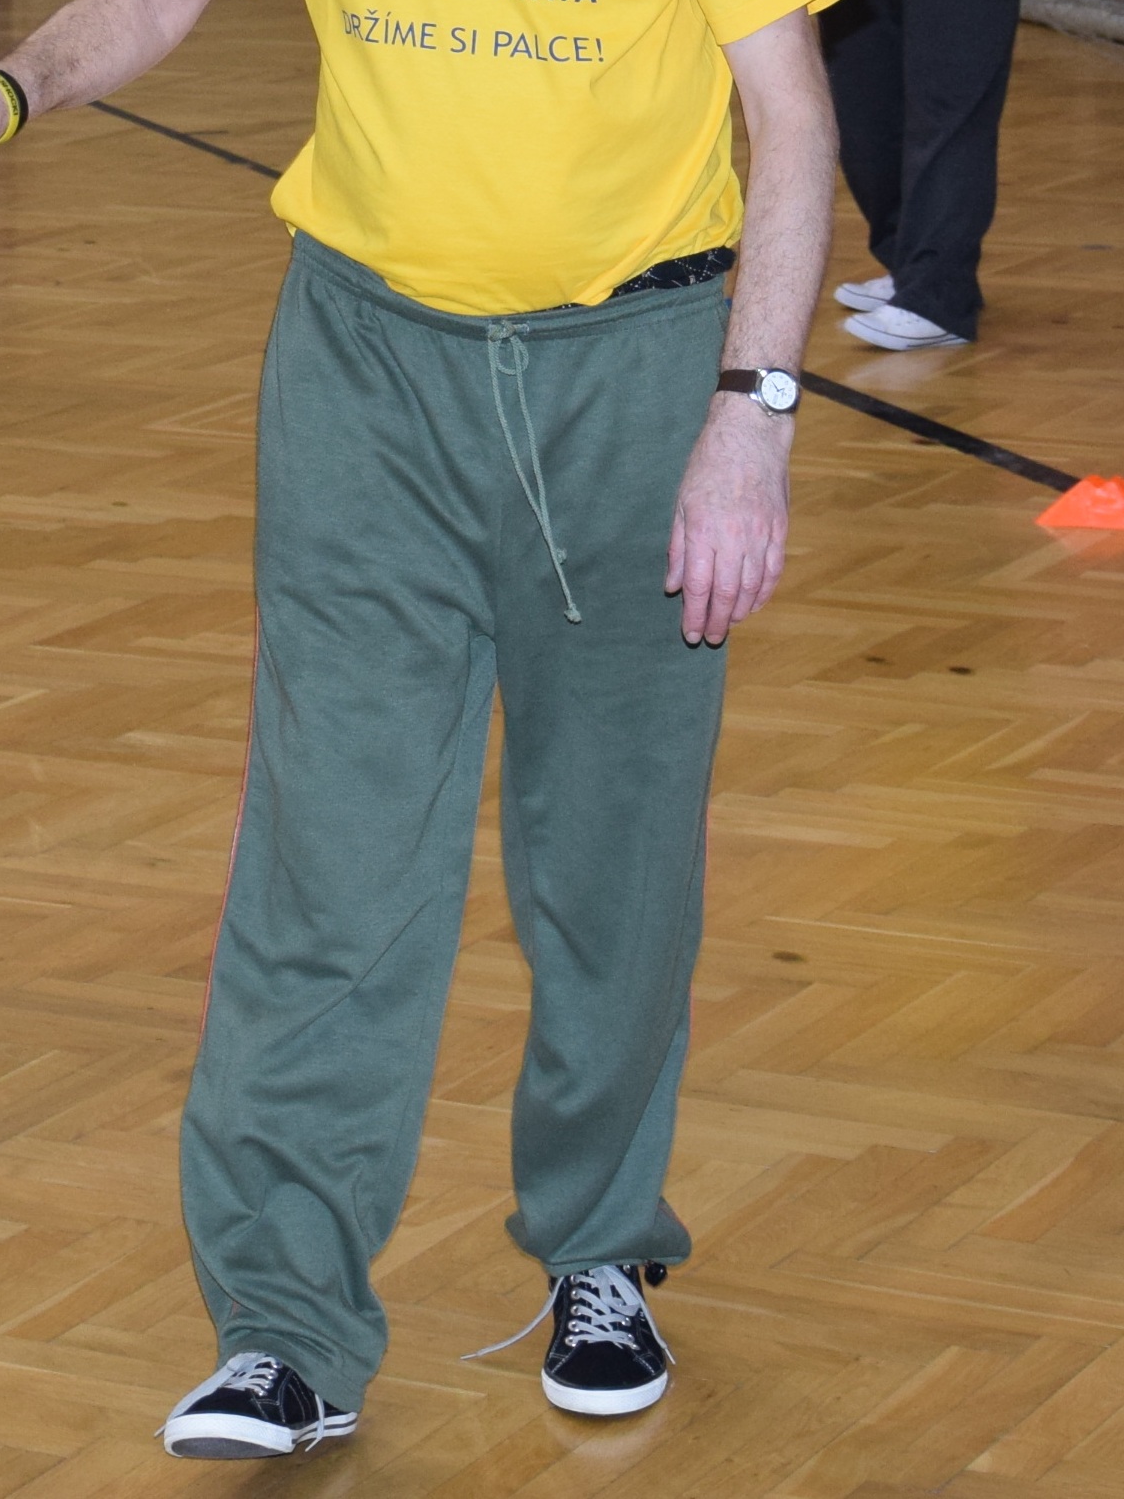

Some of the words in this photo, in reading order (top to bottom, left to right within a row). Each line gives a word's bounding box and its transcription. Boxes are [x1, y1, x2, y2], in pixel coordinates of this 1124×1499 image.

[343, 8, 438, 50] DRŽÍME
[450, 27, 477, 55] SI
[493, 31, 605, 62] PALCE!
